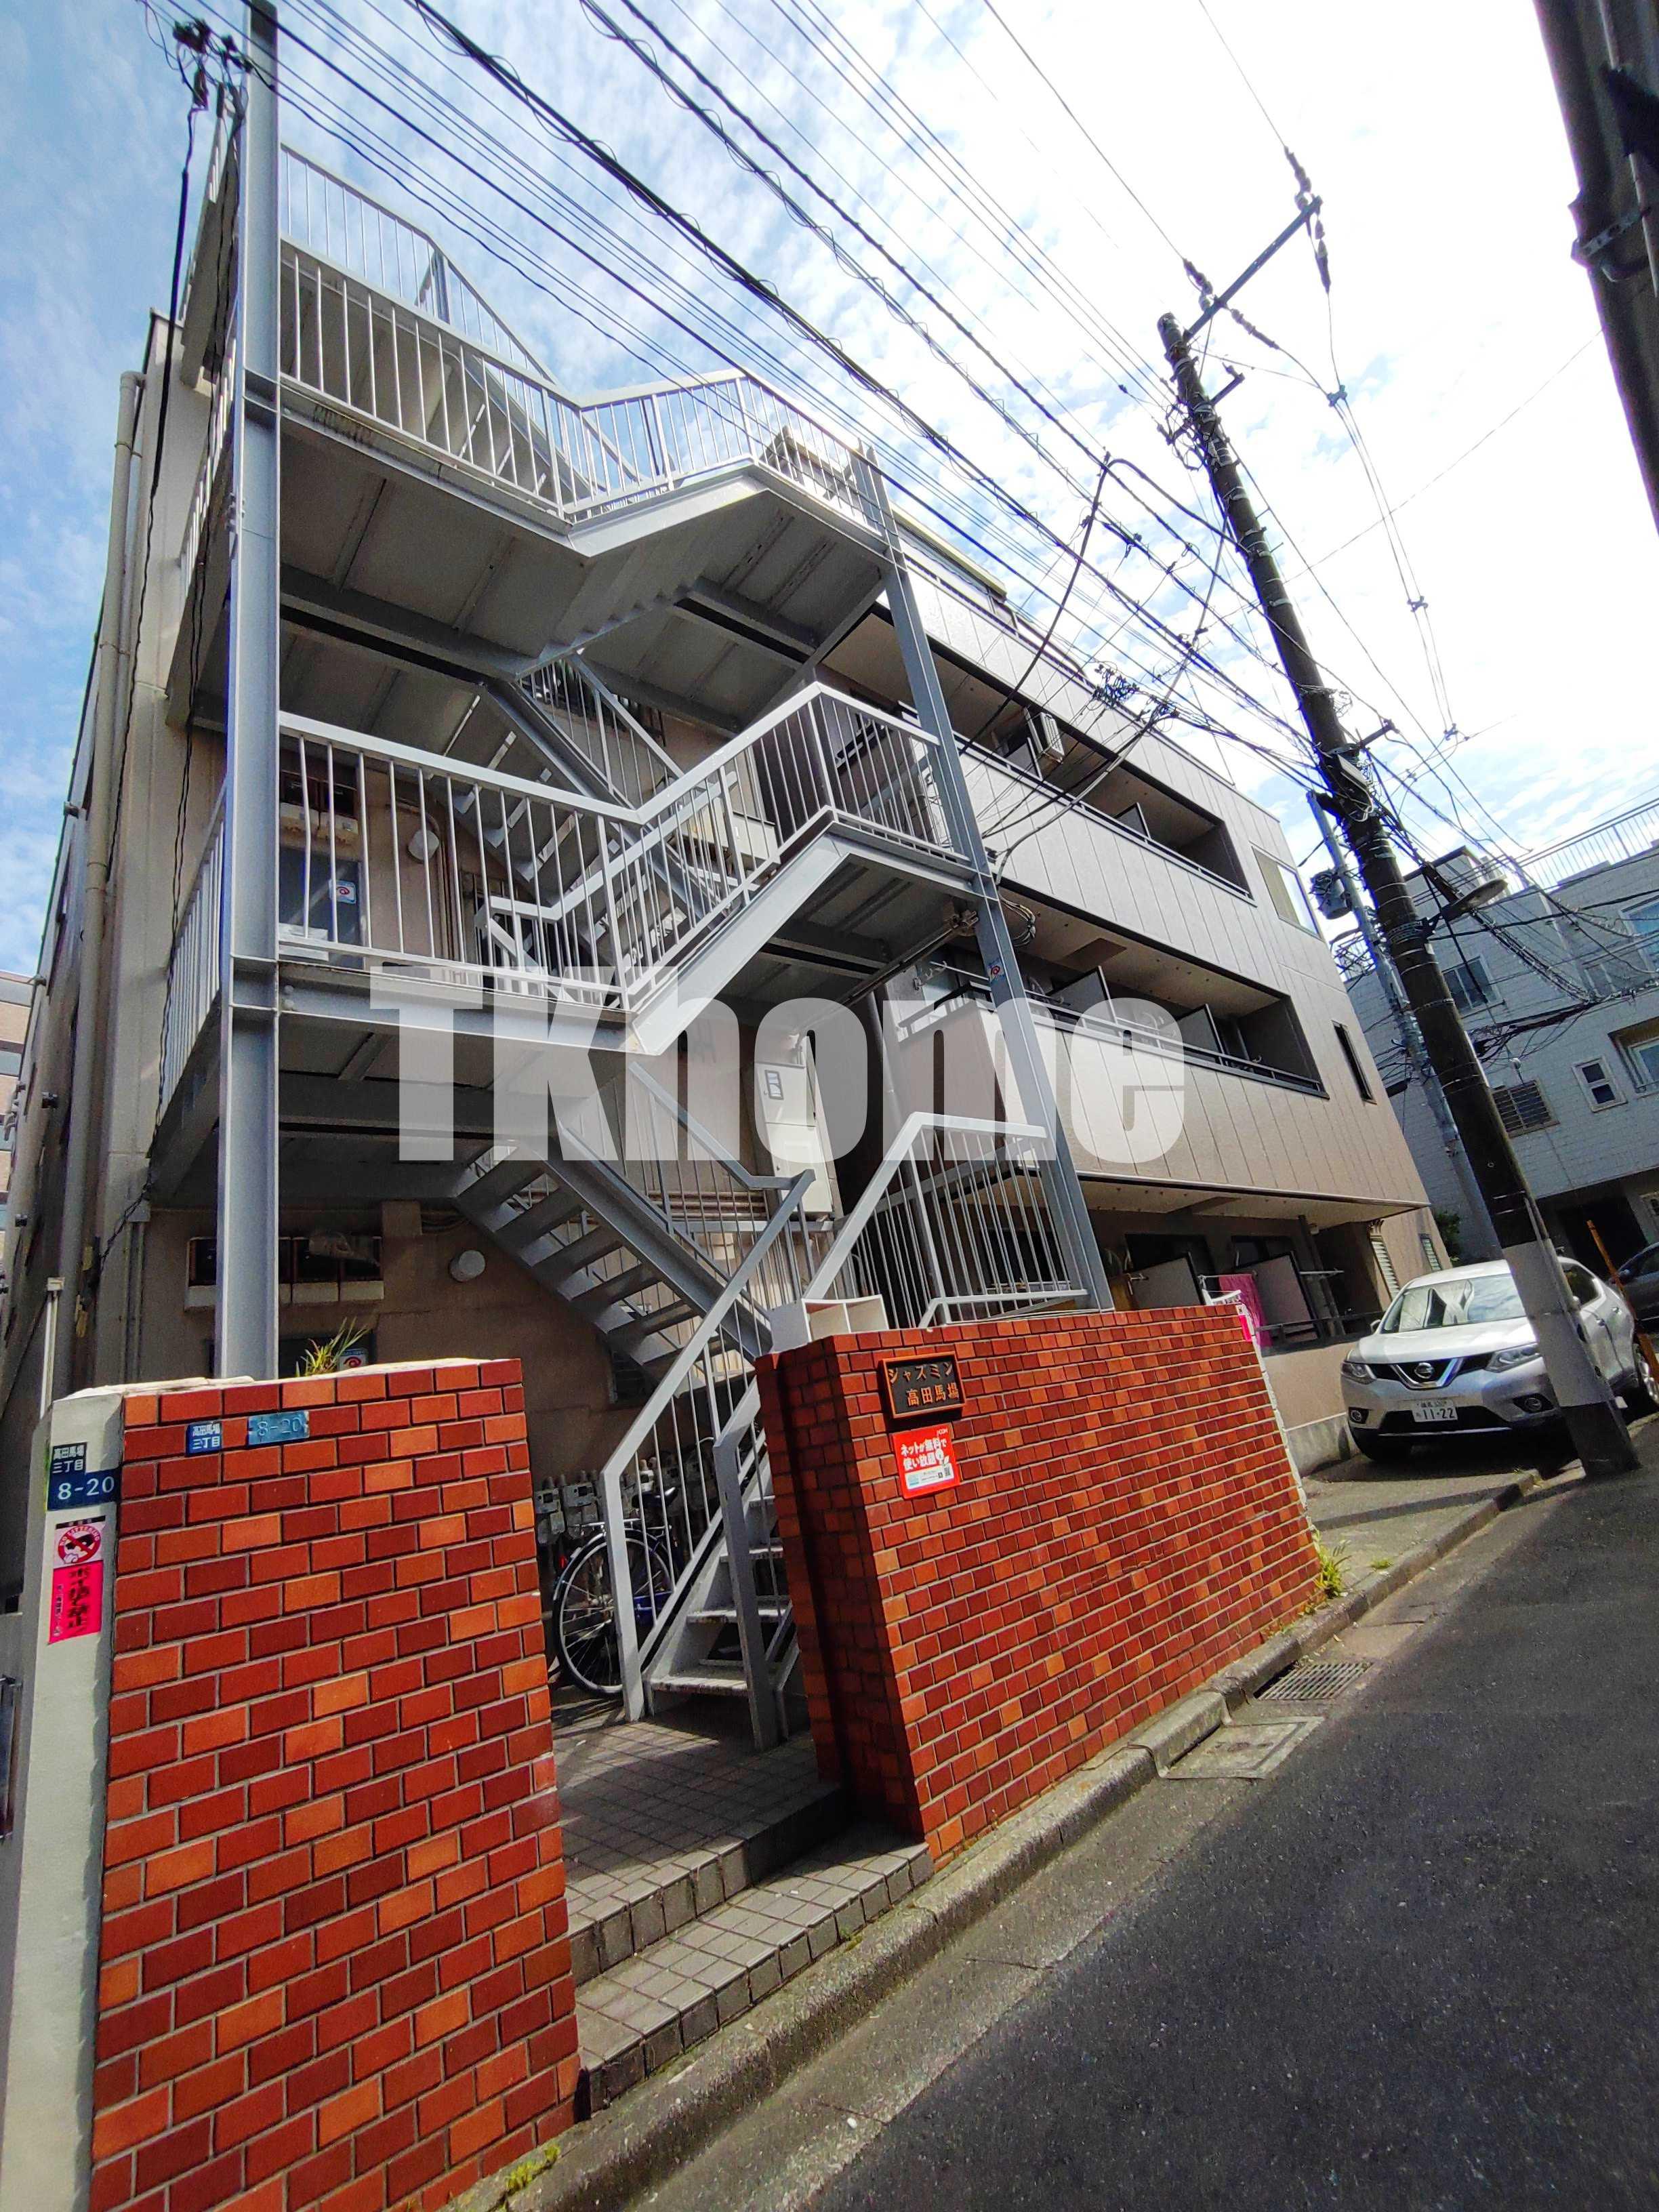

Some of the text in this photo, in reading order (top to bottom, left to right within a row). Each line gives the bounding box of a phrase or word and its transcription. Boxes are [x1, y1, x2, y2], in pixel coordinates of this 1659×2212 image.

[905, 1382, 959, 1407] 高田馬場
[258, 1417, 302, 1436] 8-20
[192, 1436, 220, 1450] 三丁目
[52, 1459, 83, 1473] 三丁目
[58, 1477, 115, 1500] 8-20
